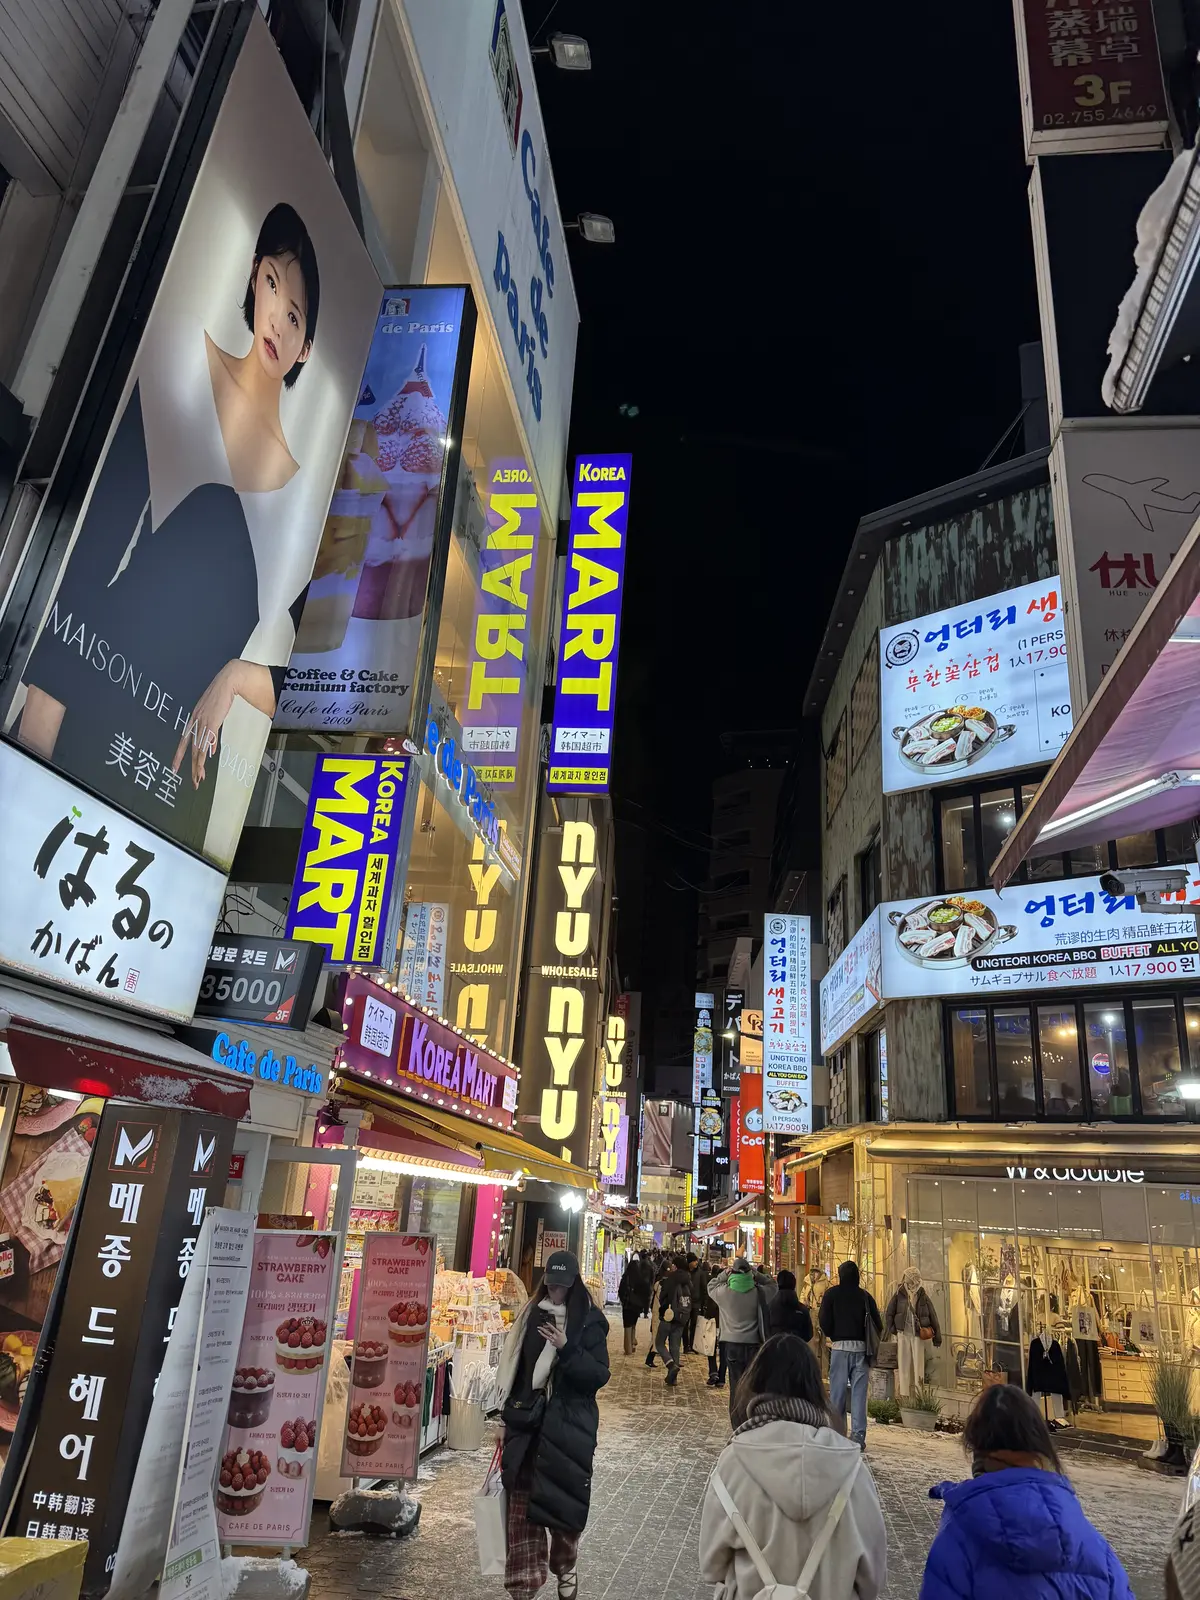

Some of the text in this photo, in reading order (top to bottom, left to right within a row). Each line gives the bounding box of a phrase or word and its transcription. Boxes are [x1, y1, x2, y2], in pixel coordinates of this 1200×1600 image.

[1091, 0, 1143, 63] 瑞草
[1073, 74, 1132, 107] 3F
[1042, 104, 1157, 126] 02.755.4649
[521, 128, 555, 359] Cafe de
[381, 321, 454, 334] de Paris
[561, 491, 625, 712] MART
[924, 590, 1065, 652] 엉터리 생
[45, 601, 143, 697] MAISON
[143, 681, 174, 723] DE
[173, 706, 217, 758] HAIR
[286, 668, 399, 682] Coffee & Cake
[905, 652, 1000, 692] 무한꽃삼겹
[281, 681, 410, 697] remium factory
[280, 699, 393, 720] Cafe de Paris
[321, 715, 353, 725] 2009
[561, 729, 606, 740] ケイマート
[105, 731, 183, 808] 美容室
[291, 758, 376, 961] MART
[33, 815, 175, 950] はるの
[357, 857, 384, 959] 세계과자 할인점
[30, 919, 120, 989] かばん
[769, 937, 787, 983] 엉터리
[976, 940, 1200, 969] UNGTEORI KOREA BBQ BUFFET ALL YO
[541, 965, 599, 979] WHOLESALE
[274, 1009, 290, 1022] 3F
[767, 986, 786, 1034] 생고기
[211, 1031, 323, 1094] Cafe de Paris
[768, 1063, 808, 1072] KOREA BBQ
[770, 1054, 806, 1063] UNGTEORI
[776, 1079, 800, 1087] BUFFET
[544, 1237, 566, 1249] SALE
[257, 1261, 327, 1274] STRAWBERRY
[371, 1257, 427, 1267] STRAWBERRY
[387, 1267, 409, 1275] CAKE
[276, 1272, 305, 1284] CAKE
[250, 1289, 277, 1300] 100%
[32, 1490, 96, 1518] 中韩翻译
[228, 1522, 249, 1531] CAFE
[266, 1524, 291, 1532] PARIS
